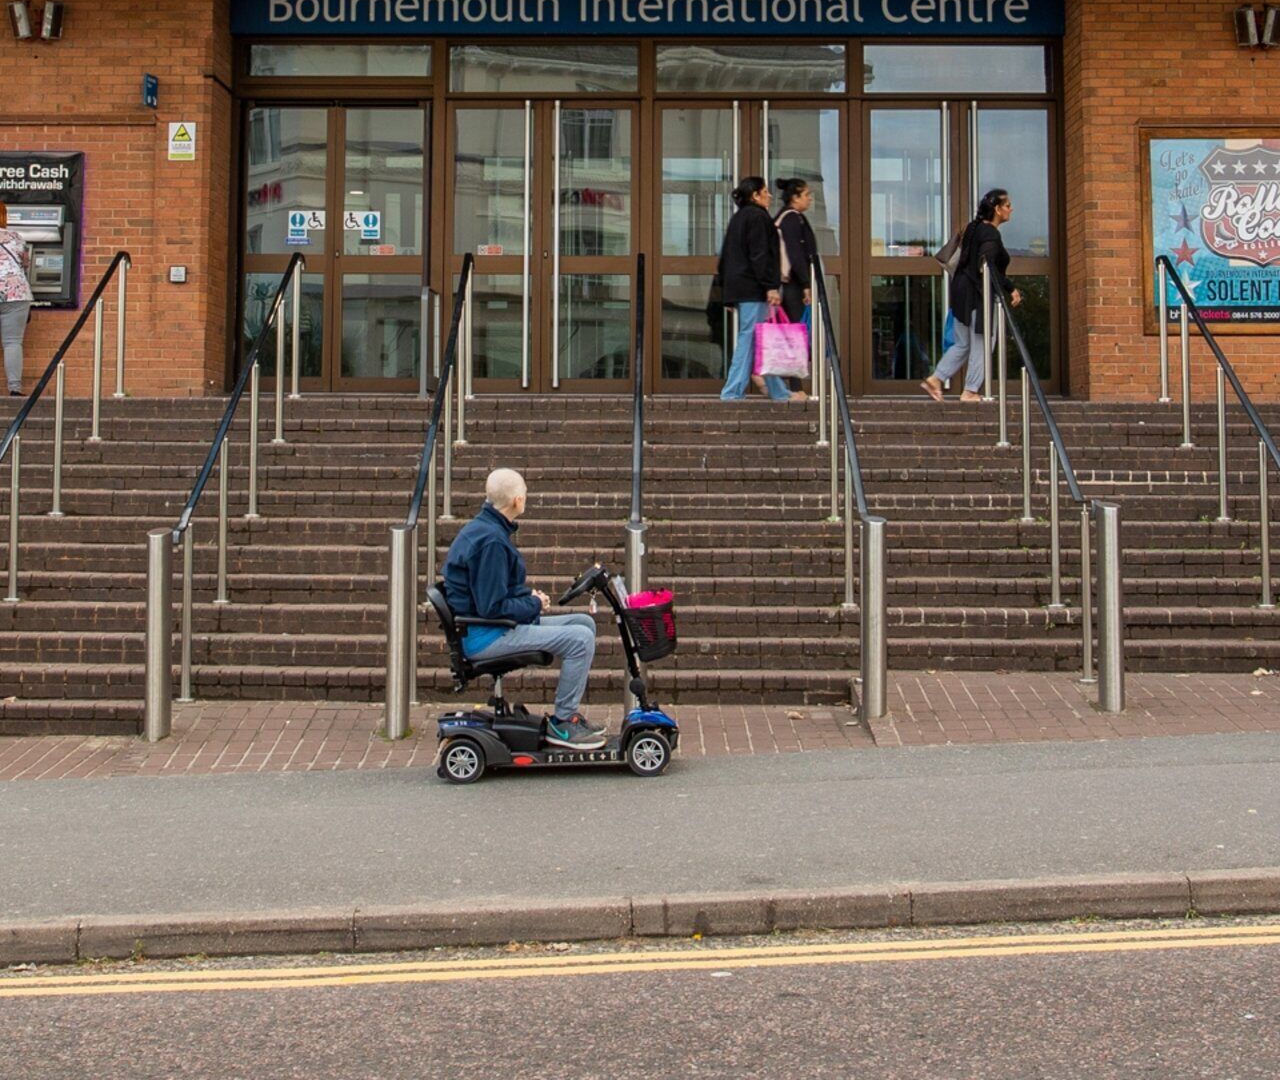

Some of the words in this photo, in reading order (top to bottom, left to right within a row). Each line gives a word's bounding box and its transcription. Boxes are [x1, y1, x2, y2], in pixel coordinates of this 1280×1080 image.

[29, 163, 69, 178] Cash
[1207, 280, 1273, 301] SOLENT
[1231, 311, 1249, 319] 0844
